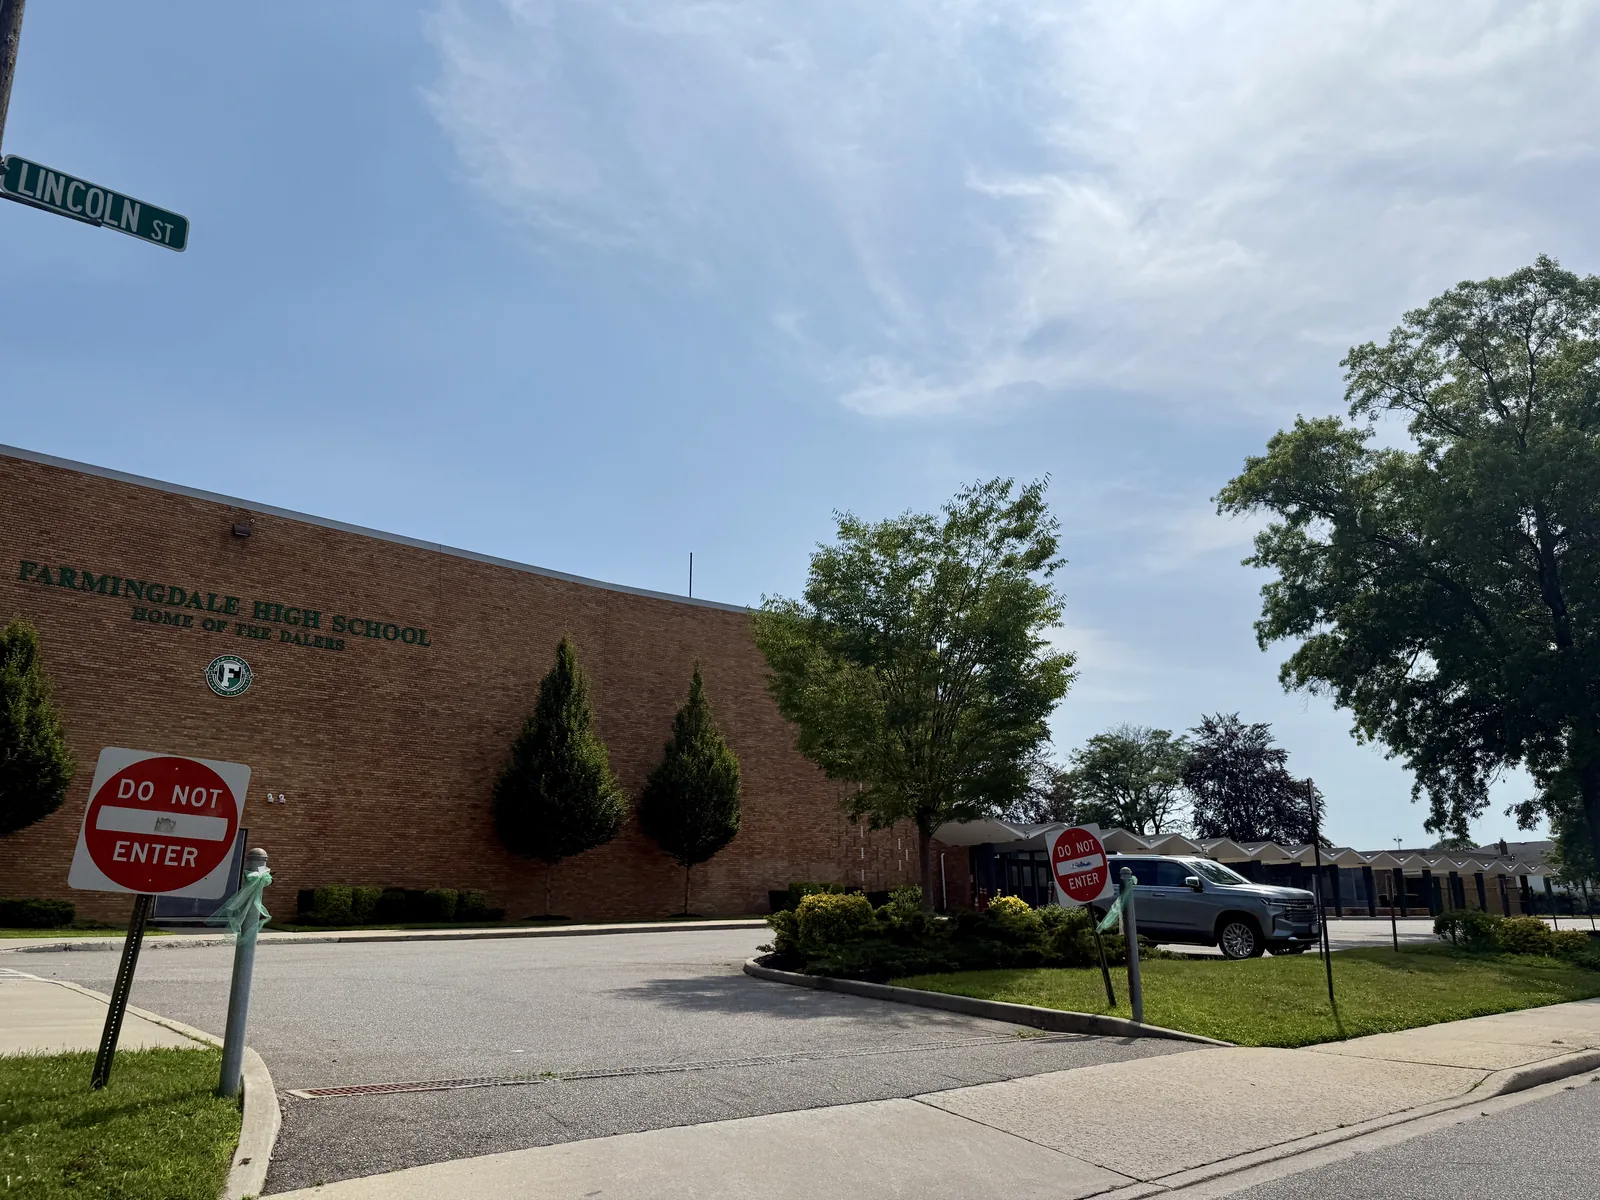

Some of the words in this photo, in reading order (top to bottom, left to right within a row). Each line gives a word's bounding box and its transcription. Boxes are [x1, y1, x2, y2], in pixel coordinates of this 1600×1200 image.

[18, 162, 140, 232] LINCOLN
[151, 219, 175, 244] ST
[18, 559, 241, 616] FARMINGDALE
[252, 600, 322, 629] HIGH
[332, 614, 432, 647] SCHOOL
[131, 606, 194, 628] HOME
[202, 616, 228, 633] OF
[235, 622, 272, 641] THE
[280, 629, 346, 651] DALERS
[117, 778, 155, 802] DO
[171, 784, 223, 809] NOT
[112, 840, 199, 868] ENTER
[1057, 844, 1072, 858] DO
[1075, 839, 1095, 854] NOT
[1068, 872, 1100, 890] ENTER
